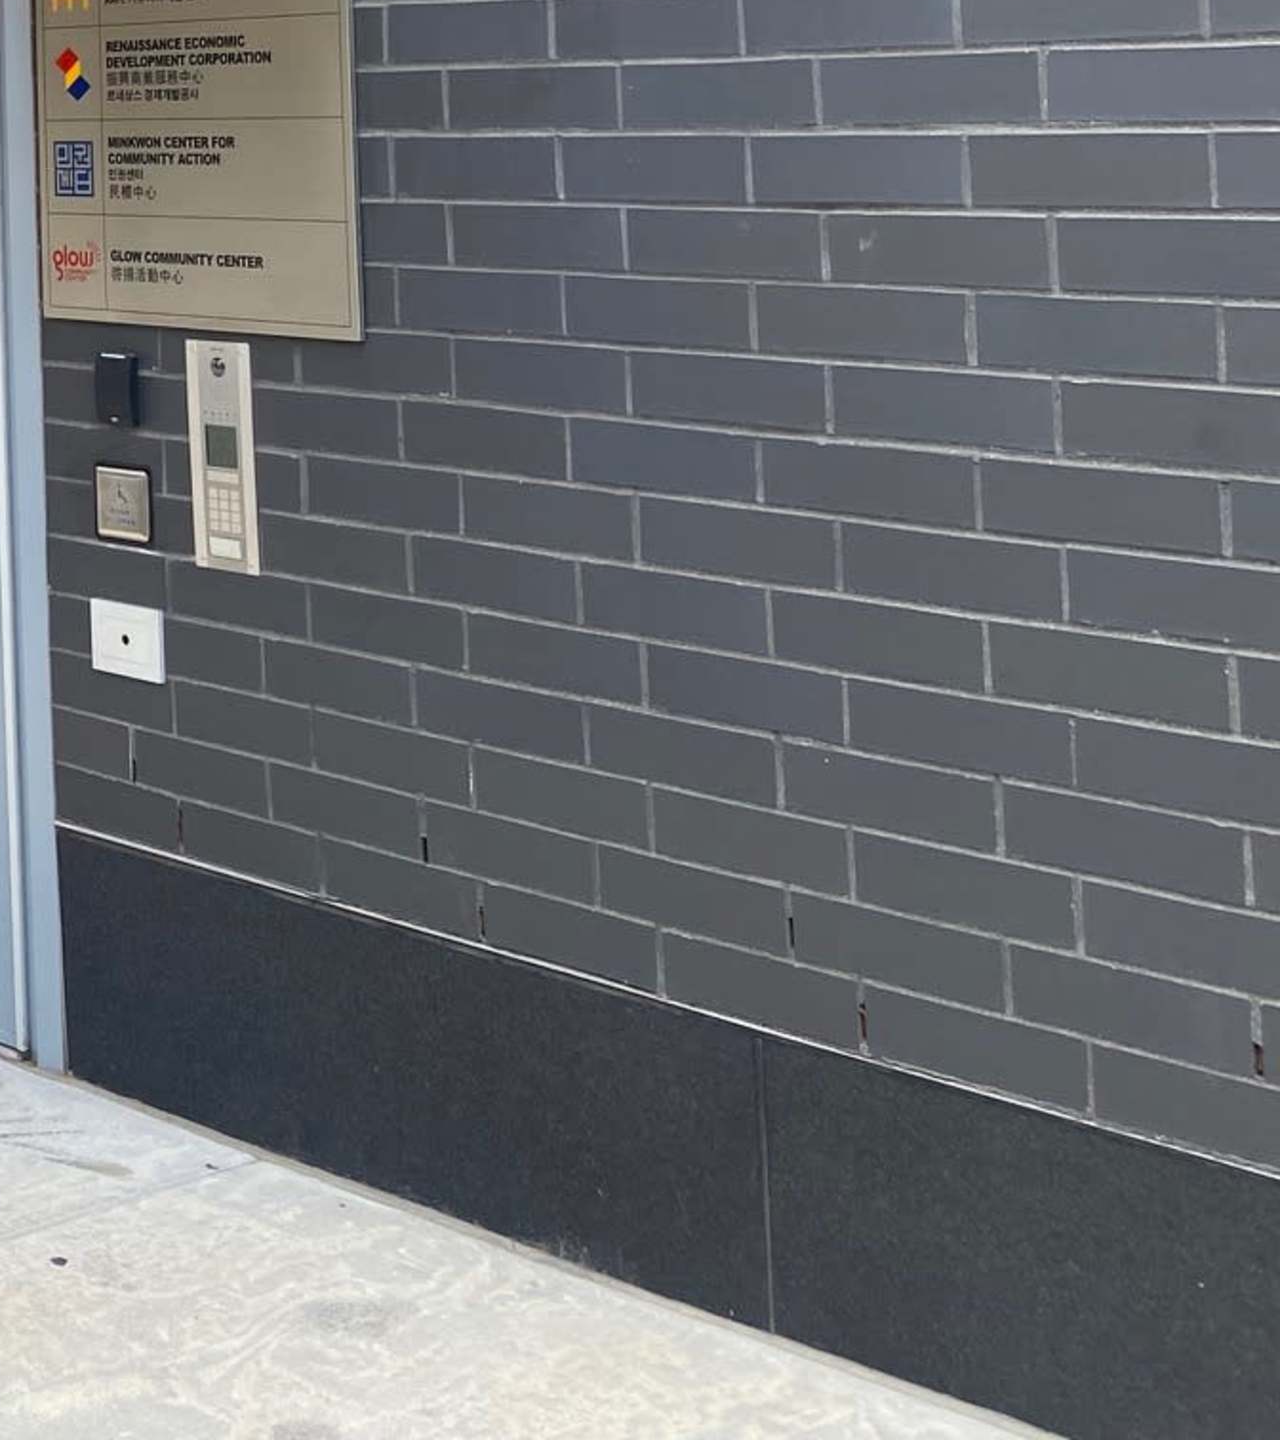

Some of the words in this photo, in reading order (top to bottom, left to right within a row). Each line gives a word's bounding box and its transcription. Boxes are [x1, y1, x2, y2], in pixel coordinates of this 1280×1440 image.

[106, 38, 181, 53] RENAISSANCE
[184, 35, 245, 50] ECONOMIC
[106, 54, 186, 69] DEVELOPMENT
[189, 50, 272, 66] CORPORATION
[108, 136, 161, 148] MINKWON
[163, 136, 209, 148] CENTER
[211, 136, 235, 148] FOR
[108, 153, 175, 165] COMMUNITY
[178, 153, 220, 165] ACTION
[53, 243, 94, 281] glow
[110, 250, 142, 264] GLOW
[144, 251, 213, 267] COMMUNITY
[216, 254, 264, 270] CENTER
